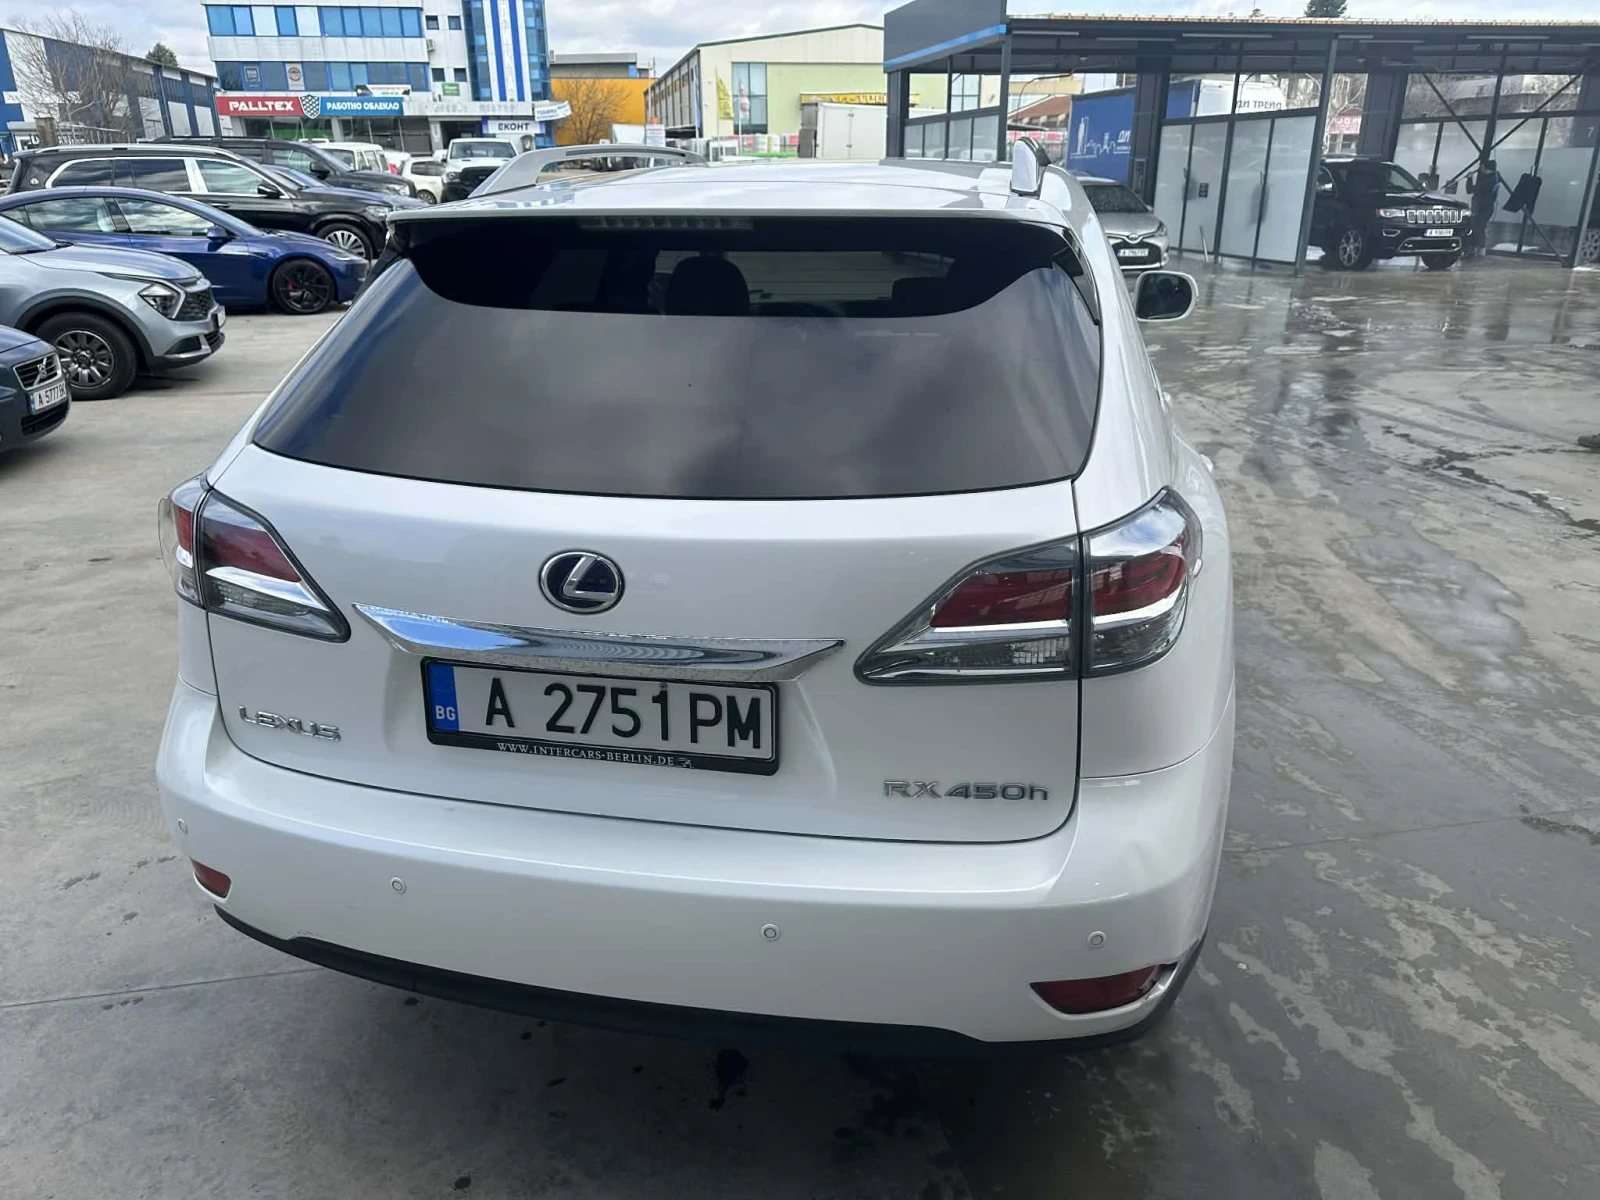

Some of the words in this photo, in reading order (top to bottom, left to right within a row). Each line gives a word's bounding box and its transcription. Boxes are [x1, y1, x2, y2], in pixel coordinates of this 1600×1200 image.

[229, 100, 295, 112] PALLTEX
[326, 101, 361, 111] РАБОТНО
[363, 101, 400, 111] ОБЛЕКЛО
[498, 122, 530, 131] ЕКОНТ
[1588, 126, 1595, 138] 7
[435, 704, 457, 722] BG
[485, 677, 516, 729] A
[543, 682, 669, 741] 2751
[689, 692, 761, 750] PM
[238, 704, 341, 742] LEXUS
[496, 742, 674, 766] WWW.INTERCARS-BERLIN.DE
